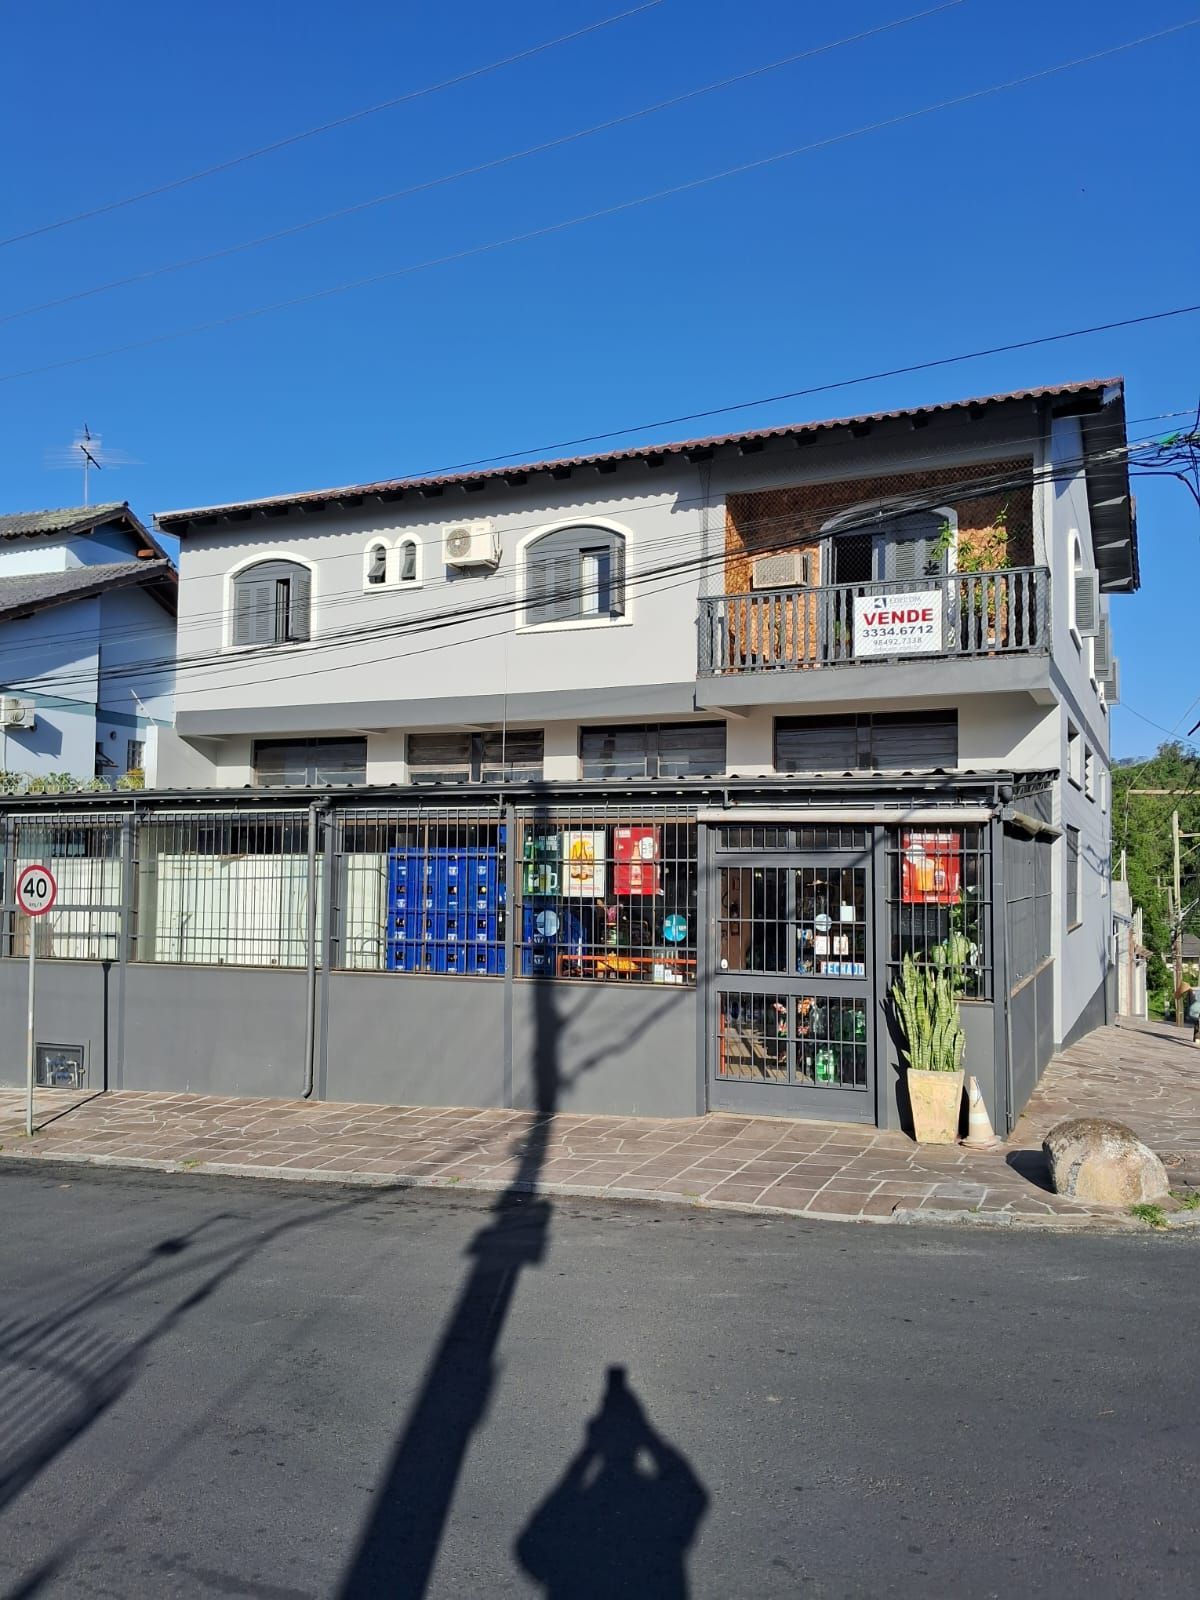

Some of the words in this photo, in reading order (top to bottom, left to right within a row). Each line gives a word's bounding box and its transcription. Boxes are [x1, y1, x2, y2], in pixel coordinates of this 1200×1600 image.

[863, 608, 934, 625] VENDE
[862, 626, 934, 638] 3334.6712
[23, 877, 47, 898] 40
